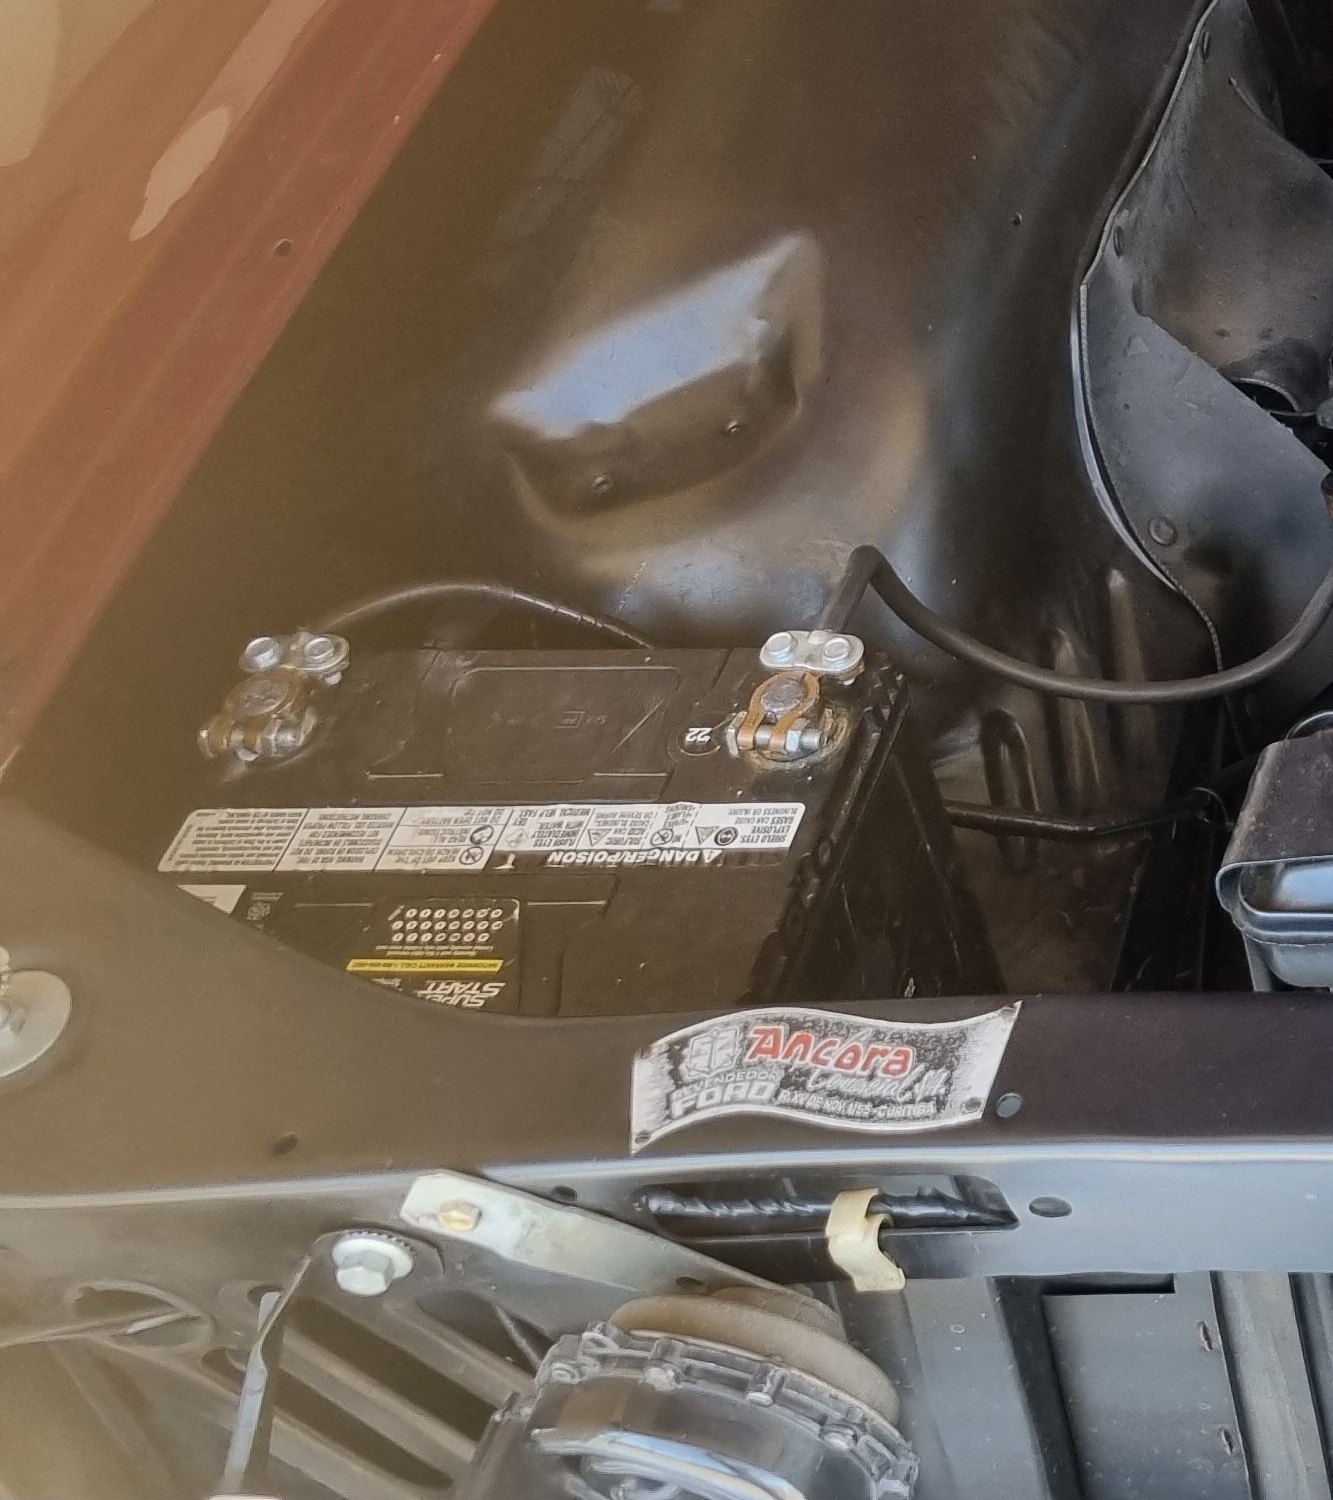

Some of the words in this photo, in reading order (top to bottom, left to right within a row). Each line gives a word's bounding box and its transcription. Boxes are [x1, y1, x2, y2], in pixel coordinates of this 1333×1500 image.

[684, 727, 712, 742] 22
[547, 849, 701, 864] DANGER/POISON
[416, 982, 506, 998] START
[671, 1069, 778, 1098] REVENDEDOR
[671, 1081, 777, 1119] FORD
